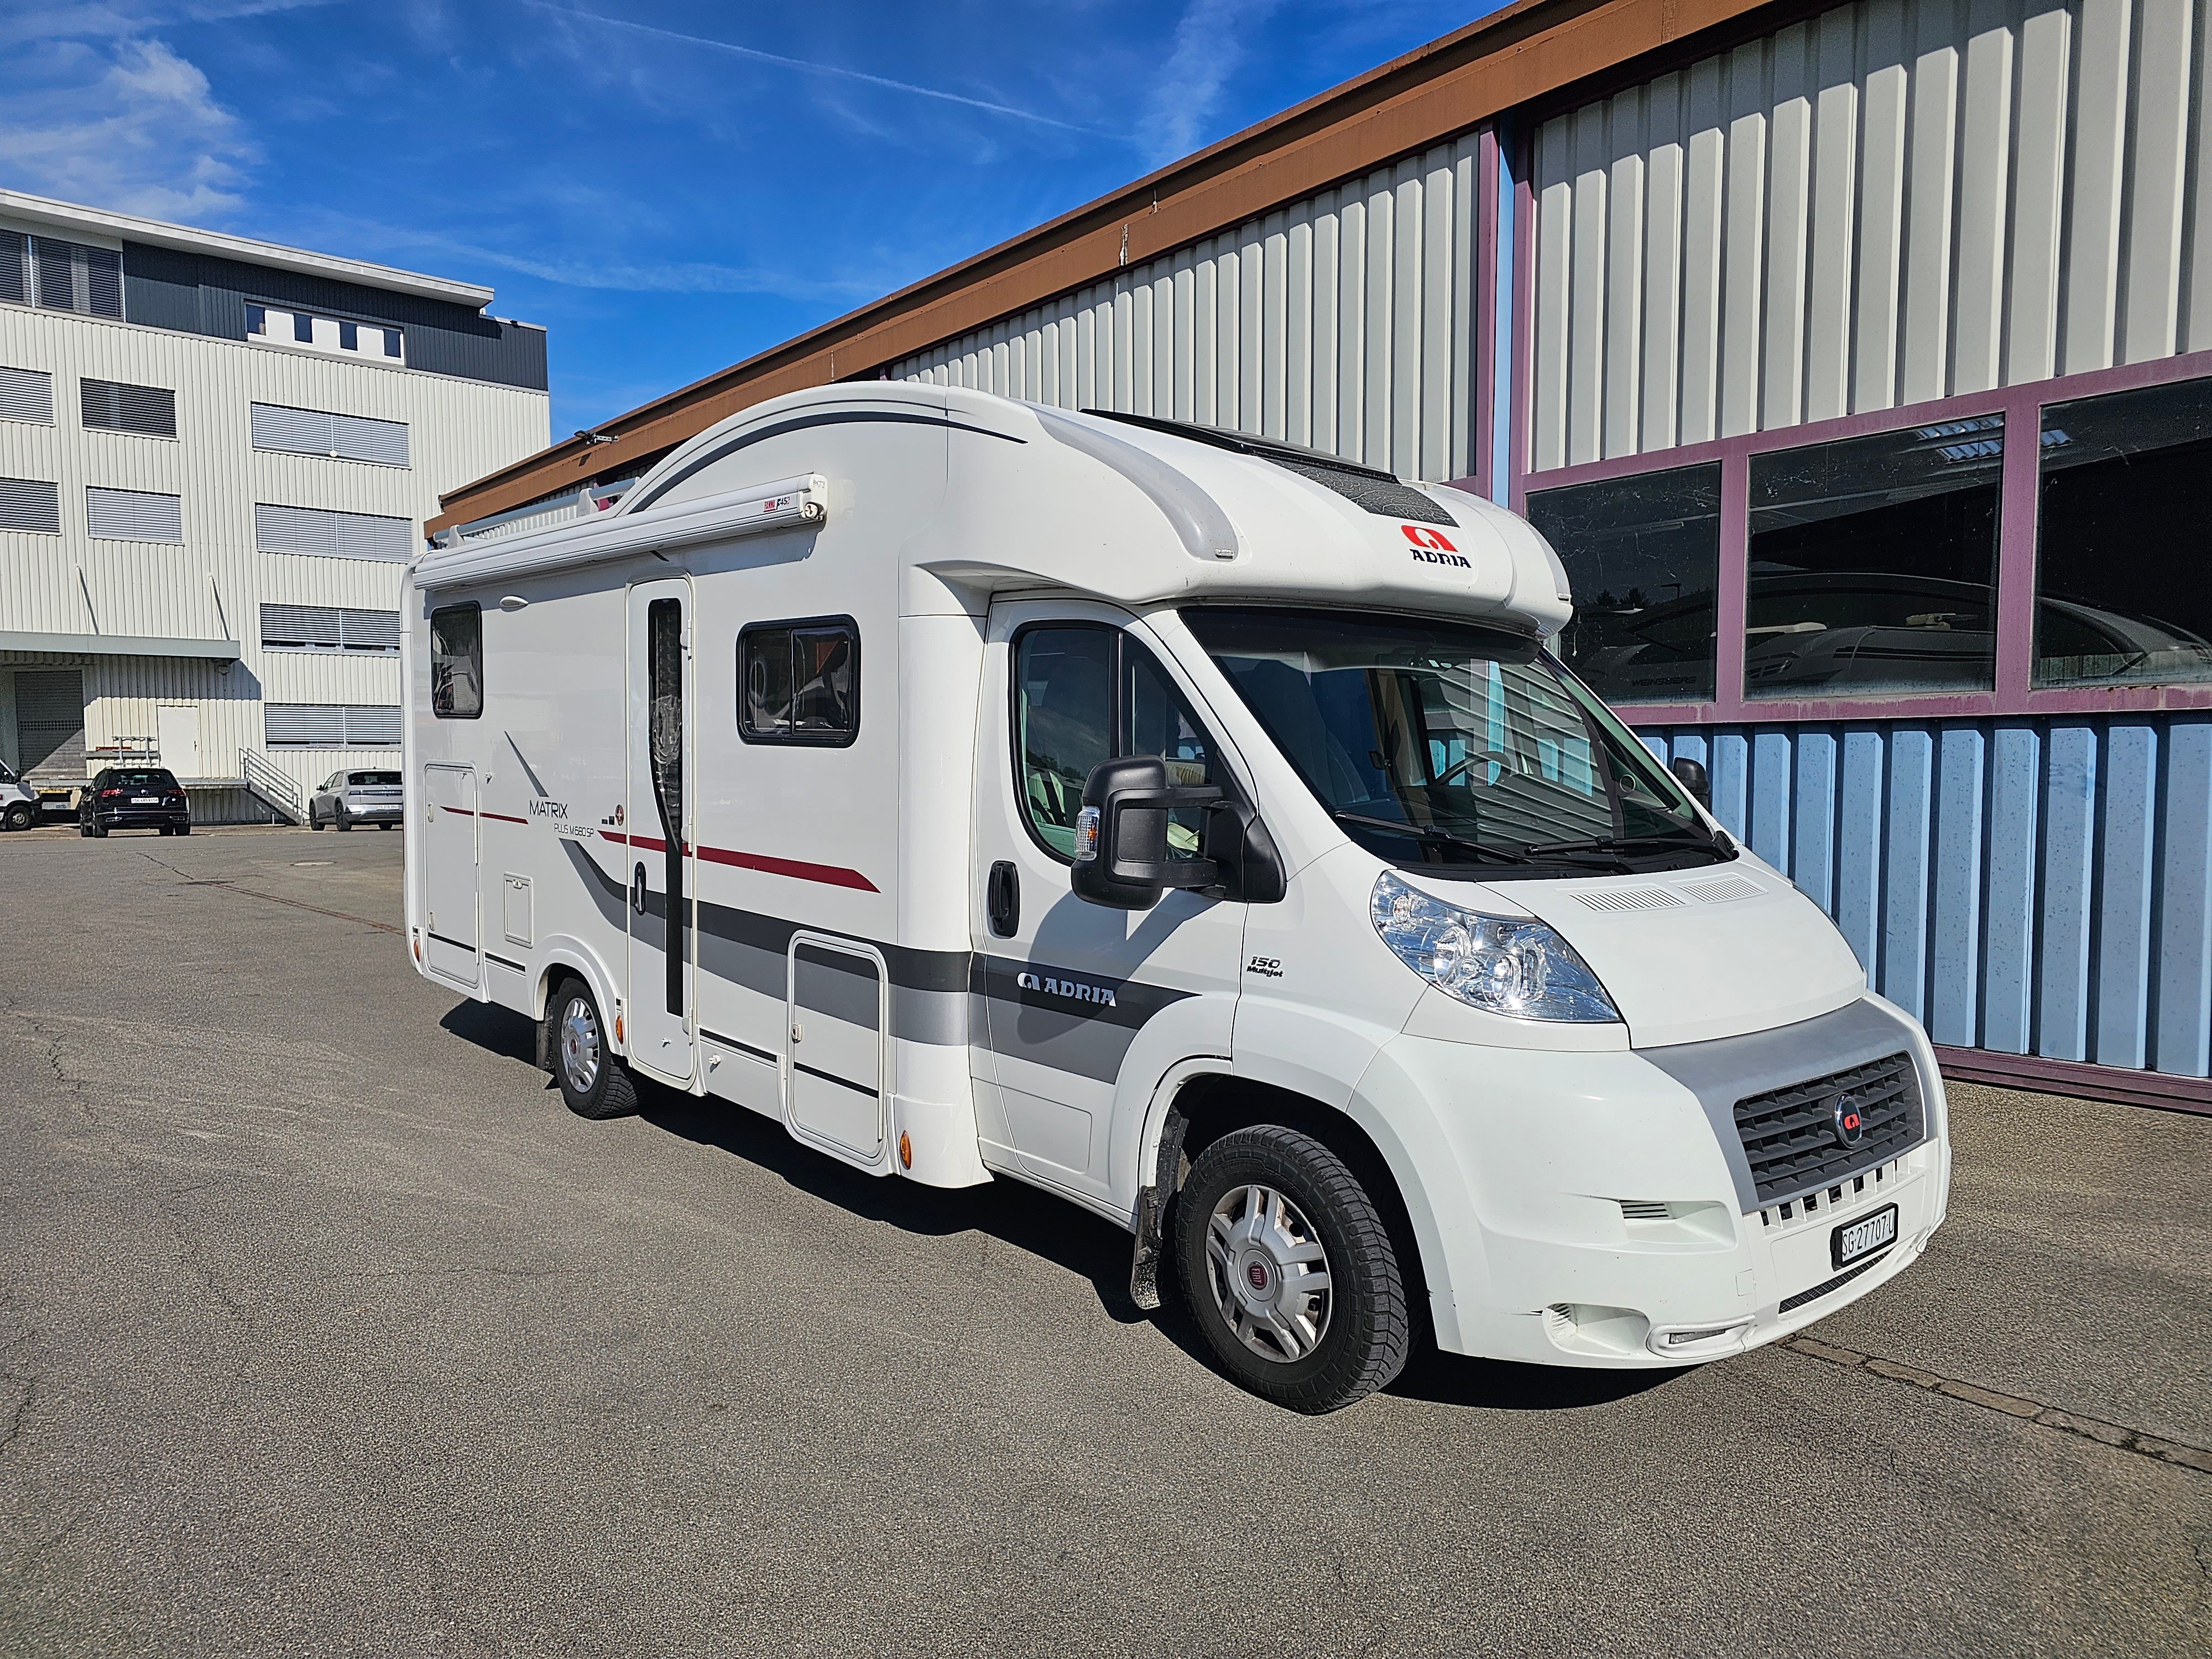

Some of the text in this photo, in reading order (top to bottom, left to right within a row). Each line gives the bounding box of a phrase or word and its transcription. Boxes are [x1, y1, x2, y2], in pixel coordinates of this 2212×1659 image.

[1410, 548, 1472, 569] ADRIA
[529, 800, 568, 820] MATRIX
[554, 823, 568, 834] PLUS
[1250, 956, 1281, 969] 150
[1246, 965, 1284, 978] Multijet
[1044, 977, 1117, 1007] ADRIA
[1251, 1267, 1262, 1284] FIAT
